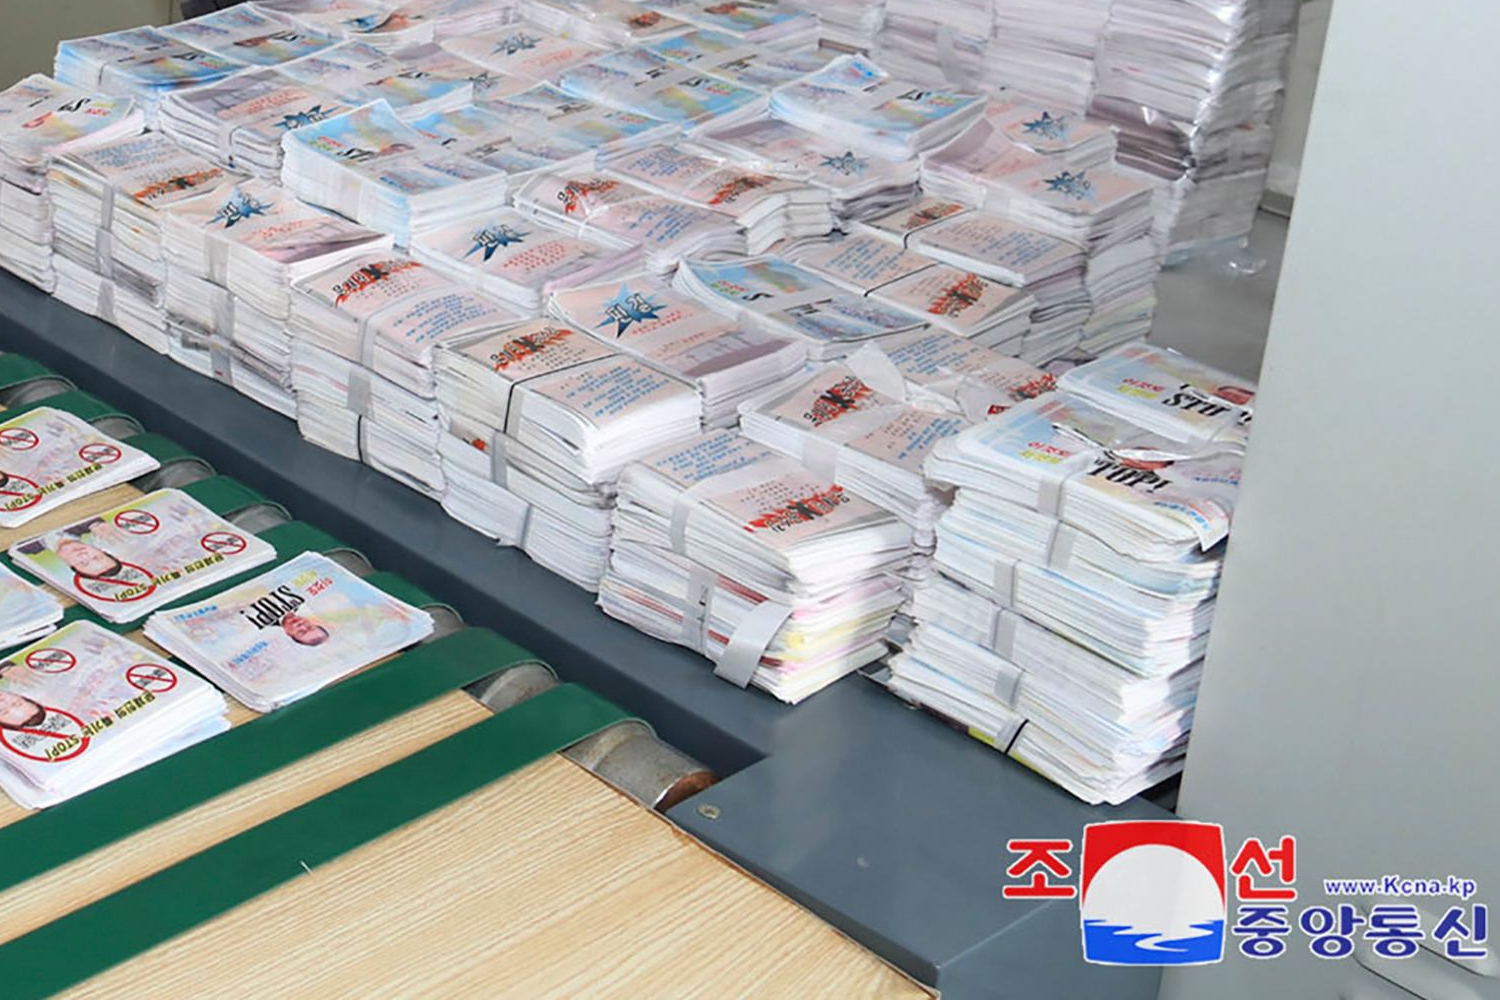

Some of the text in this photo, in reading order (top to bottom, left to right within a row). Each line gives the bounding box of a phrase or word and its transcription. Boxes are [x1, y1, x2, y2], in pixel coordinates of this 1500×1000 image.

[239, 584, 305, 630] STOP!
[113, 691, 156, 719] 문재인의
[44, 734, 81, 760] STOP!
